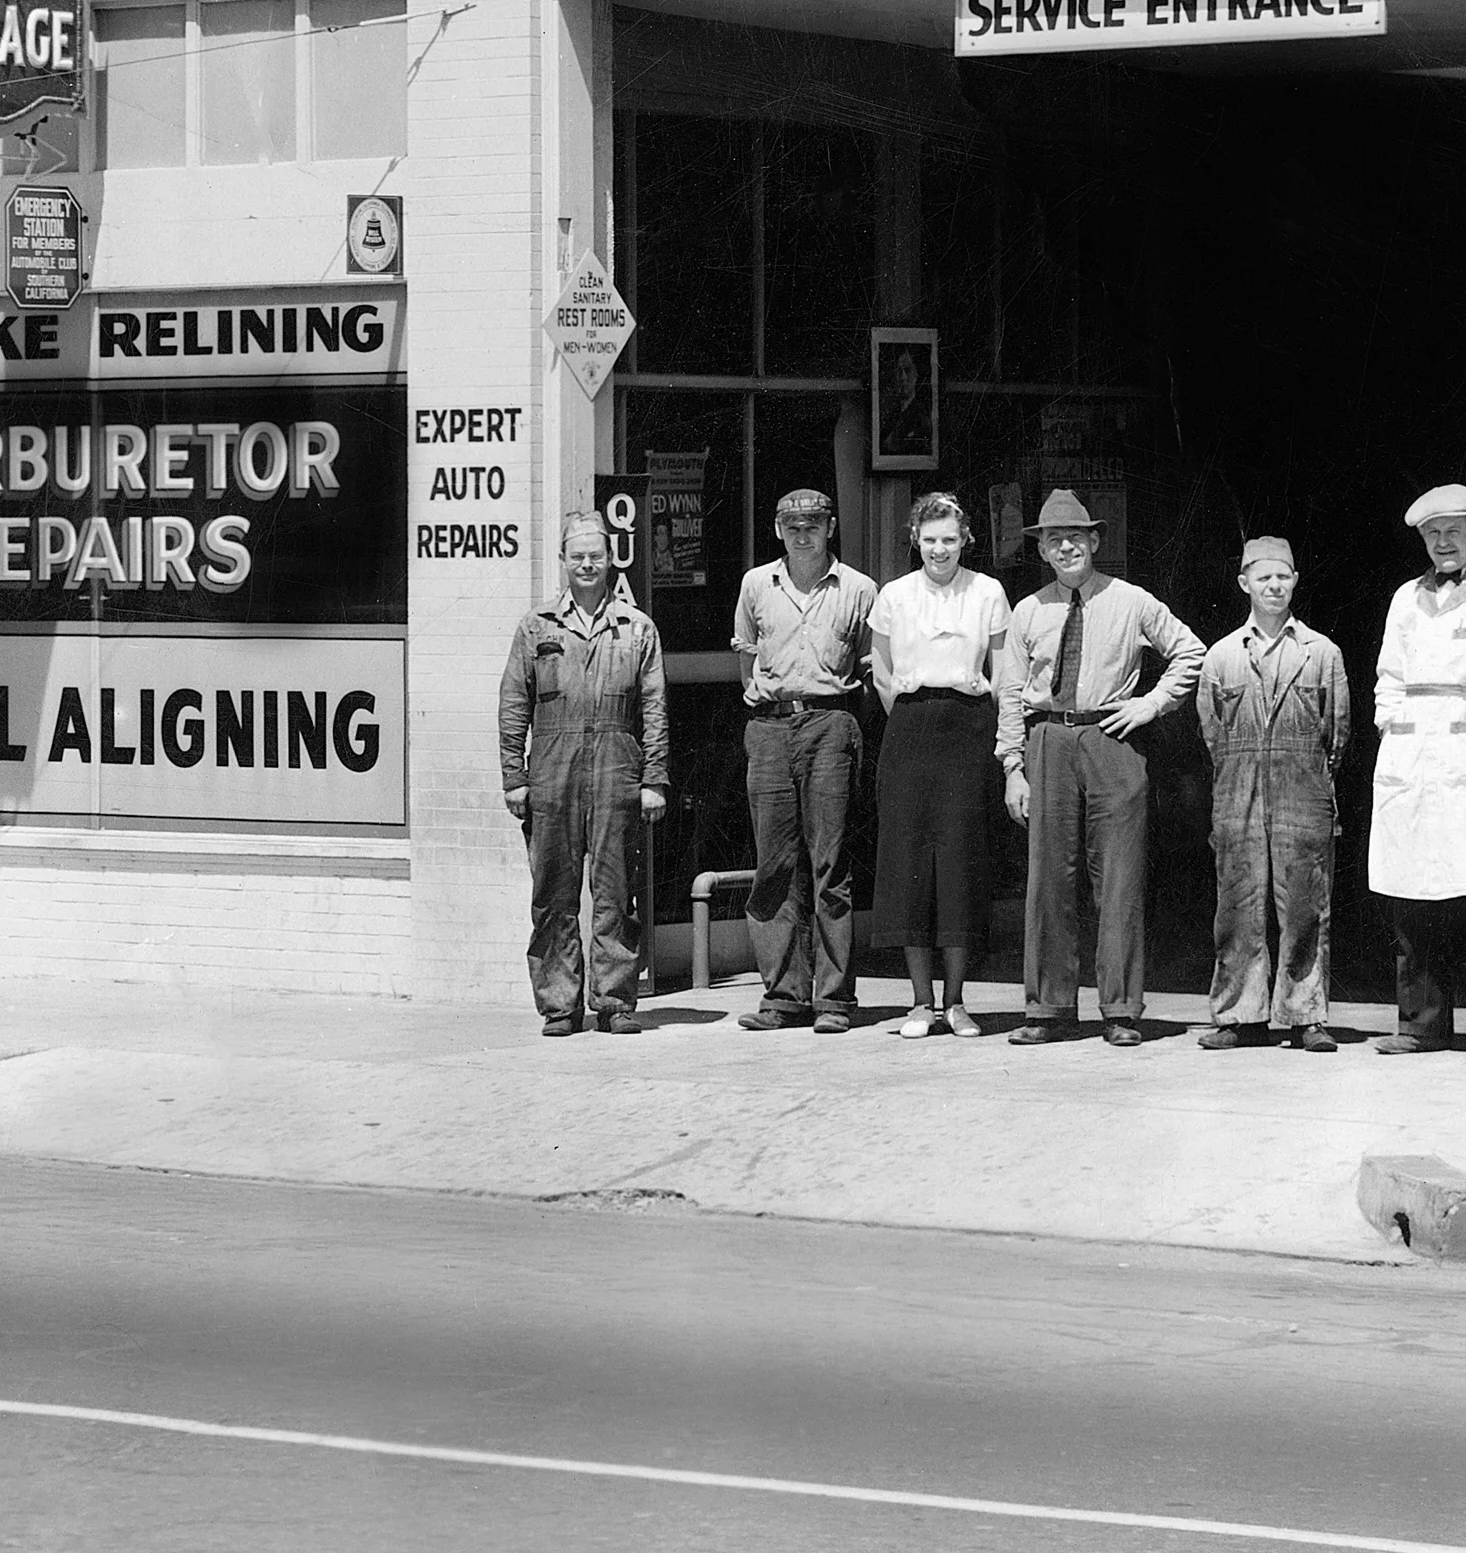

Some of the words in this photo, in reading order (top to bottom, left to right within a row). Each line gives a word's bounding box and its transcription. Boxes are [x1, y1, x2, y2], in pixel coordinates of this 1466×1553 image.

[14, 196, 72, 218] EMERGENCY
[23, 217, 65, 237] STATION
[12, 236, 29, 249] FOR
[31, 237, 76, 250] MEMBERS
[578, 276, 604, 289] CLEAN
[572, 292, 612, 305] SANITARY
[557, 307, 587, 328] REST
[591, 308, 626, 328] ROOMS
[98, 303, 386, 359] RELINING
[415, 407, 522, 445] EXPERT
[429, 466, 506, 502] AUTO
[652, 494, 667, 514] ED
[669, 493, 702, 513] WYNN
[417, 523, 520, 560] REPAIRS
[47, 686, 382, 774] ALIGNING
